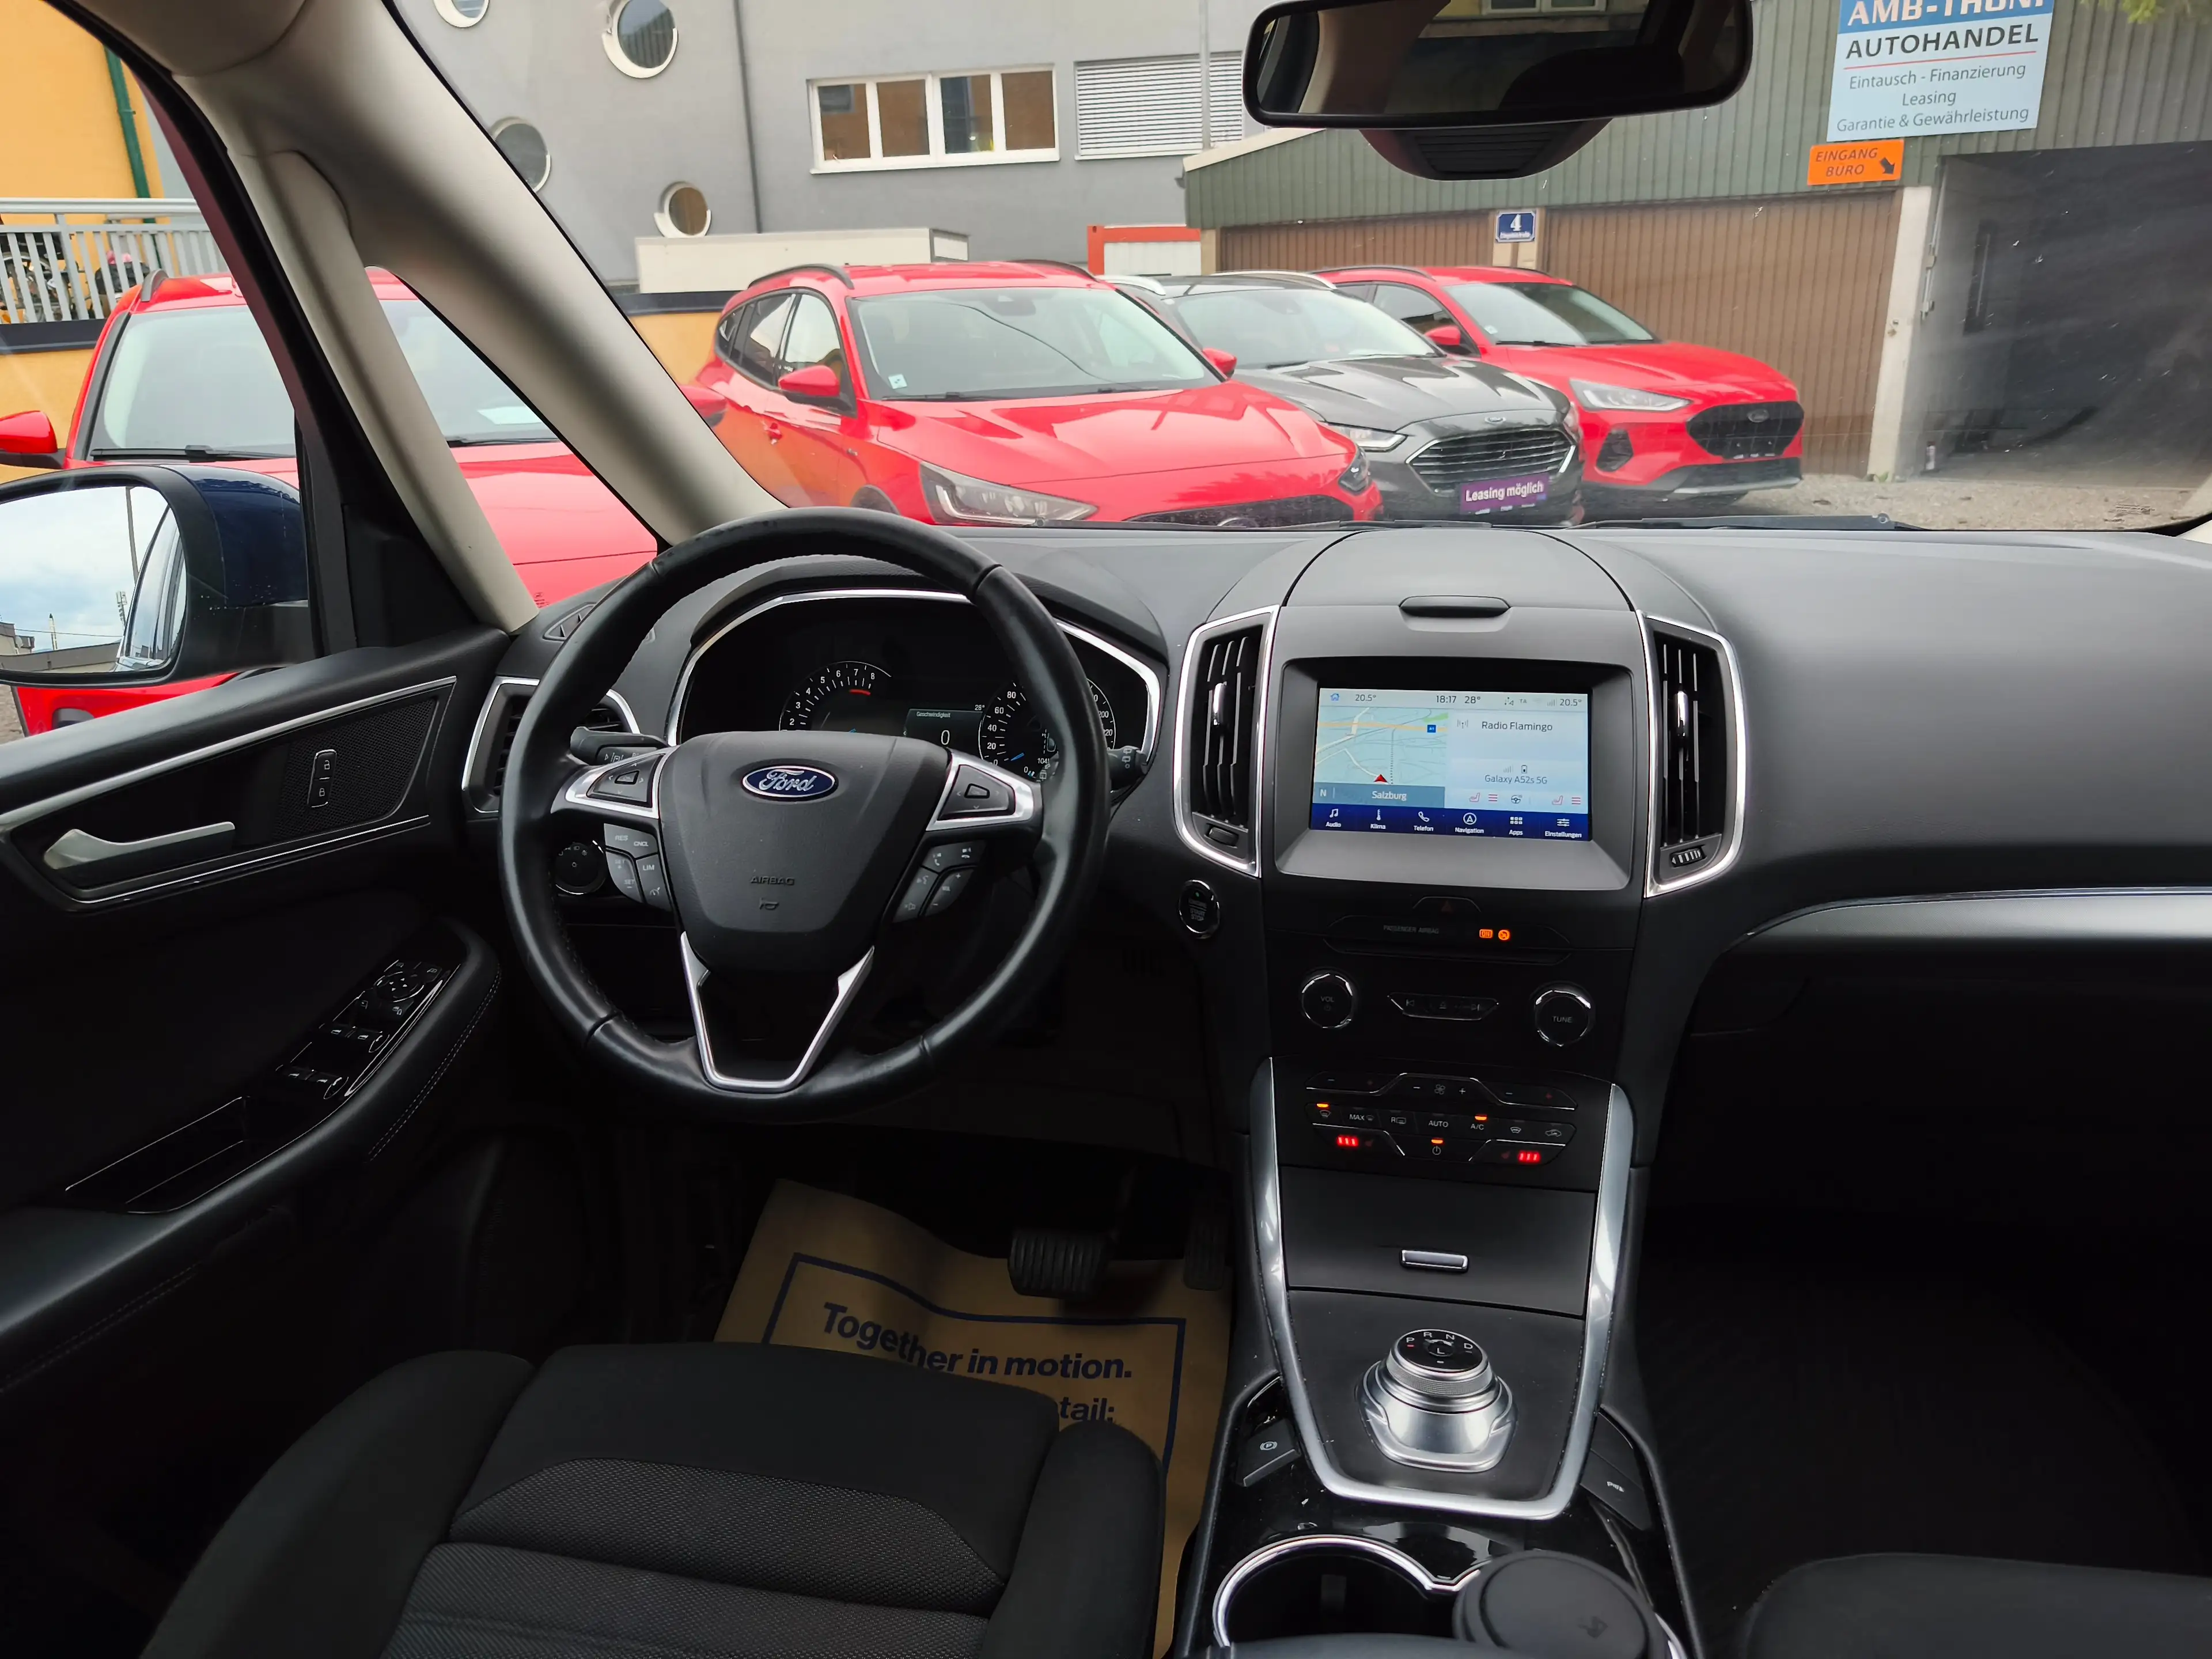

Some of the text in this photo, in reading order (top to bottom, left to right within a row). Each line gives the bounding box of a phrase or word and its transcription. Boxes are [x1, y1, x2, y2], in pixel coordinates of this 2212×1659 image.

[1846, 24, 2038, 59] AUTOHANDEL
[1850, 70, 1916, 89] Eintausch
[1930, 65, 2026, 82] Finanzierung
[1902, 91, 1956, 106] Leasing
[1837, 108, 2029, 131] Garantie & Gewährleistung
[1816, 147, 1878, 162] EINGANG
[1510, 214, 1521, 232] 4
[1465, 480, 1544, 502] Leasing möglich
[1464, 696, 1481, 704] 28°
[1559, 698, 1582, 706] 20.5°
[1482, 721, 1553, 732] Radio Flamingo
[941, 730, 950, 745] 0
[759, 768, 817, 791] Ford
[1484, 775, 1547, 785] Galaxy A52s 5G
[1372, 790, 1407, 801] Salzburg
[751, 876, 795, 886] AIRBAG
[1470, 1123, 1484, 1131] A/C
[824, 1302, 1132, 1379] Together in motion.
